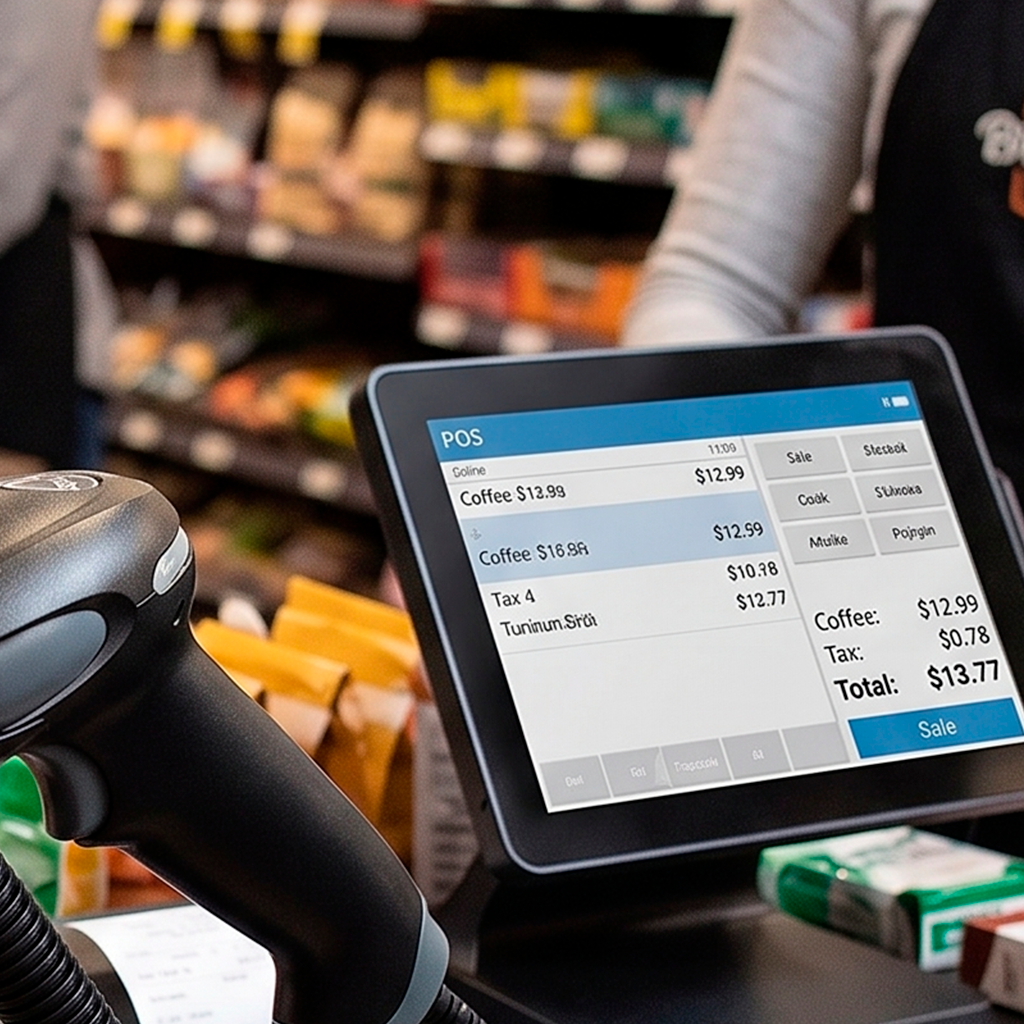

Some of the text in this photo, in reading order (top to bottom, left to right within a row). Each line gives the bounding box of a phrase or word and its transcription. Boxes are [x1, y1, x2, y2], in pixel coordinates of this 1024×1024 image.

[441, 428, 484, 448] POS
[786, 450, 813, 464] Sale
[694, 465, 745, 485] $12.99
[459, 488, 513, 506] Coffee
[479, 547, 533, 566] Coffee
[491, 591, 521, 608] Tax
[736, 589, 786, 611] $12.77
[814, 594, 979, 632] Coffee: $12.99
[824, 625, 991, 664] Tax: $0.78
[833, 659, 999, 701] Total: $13.77
[918, 718, 958, 739] Sale
